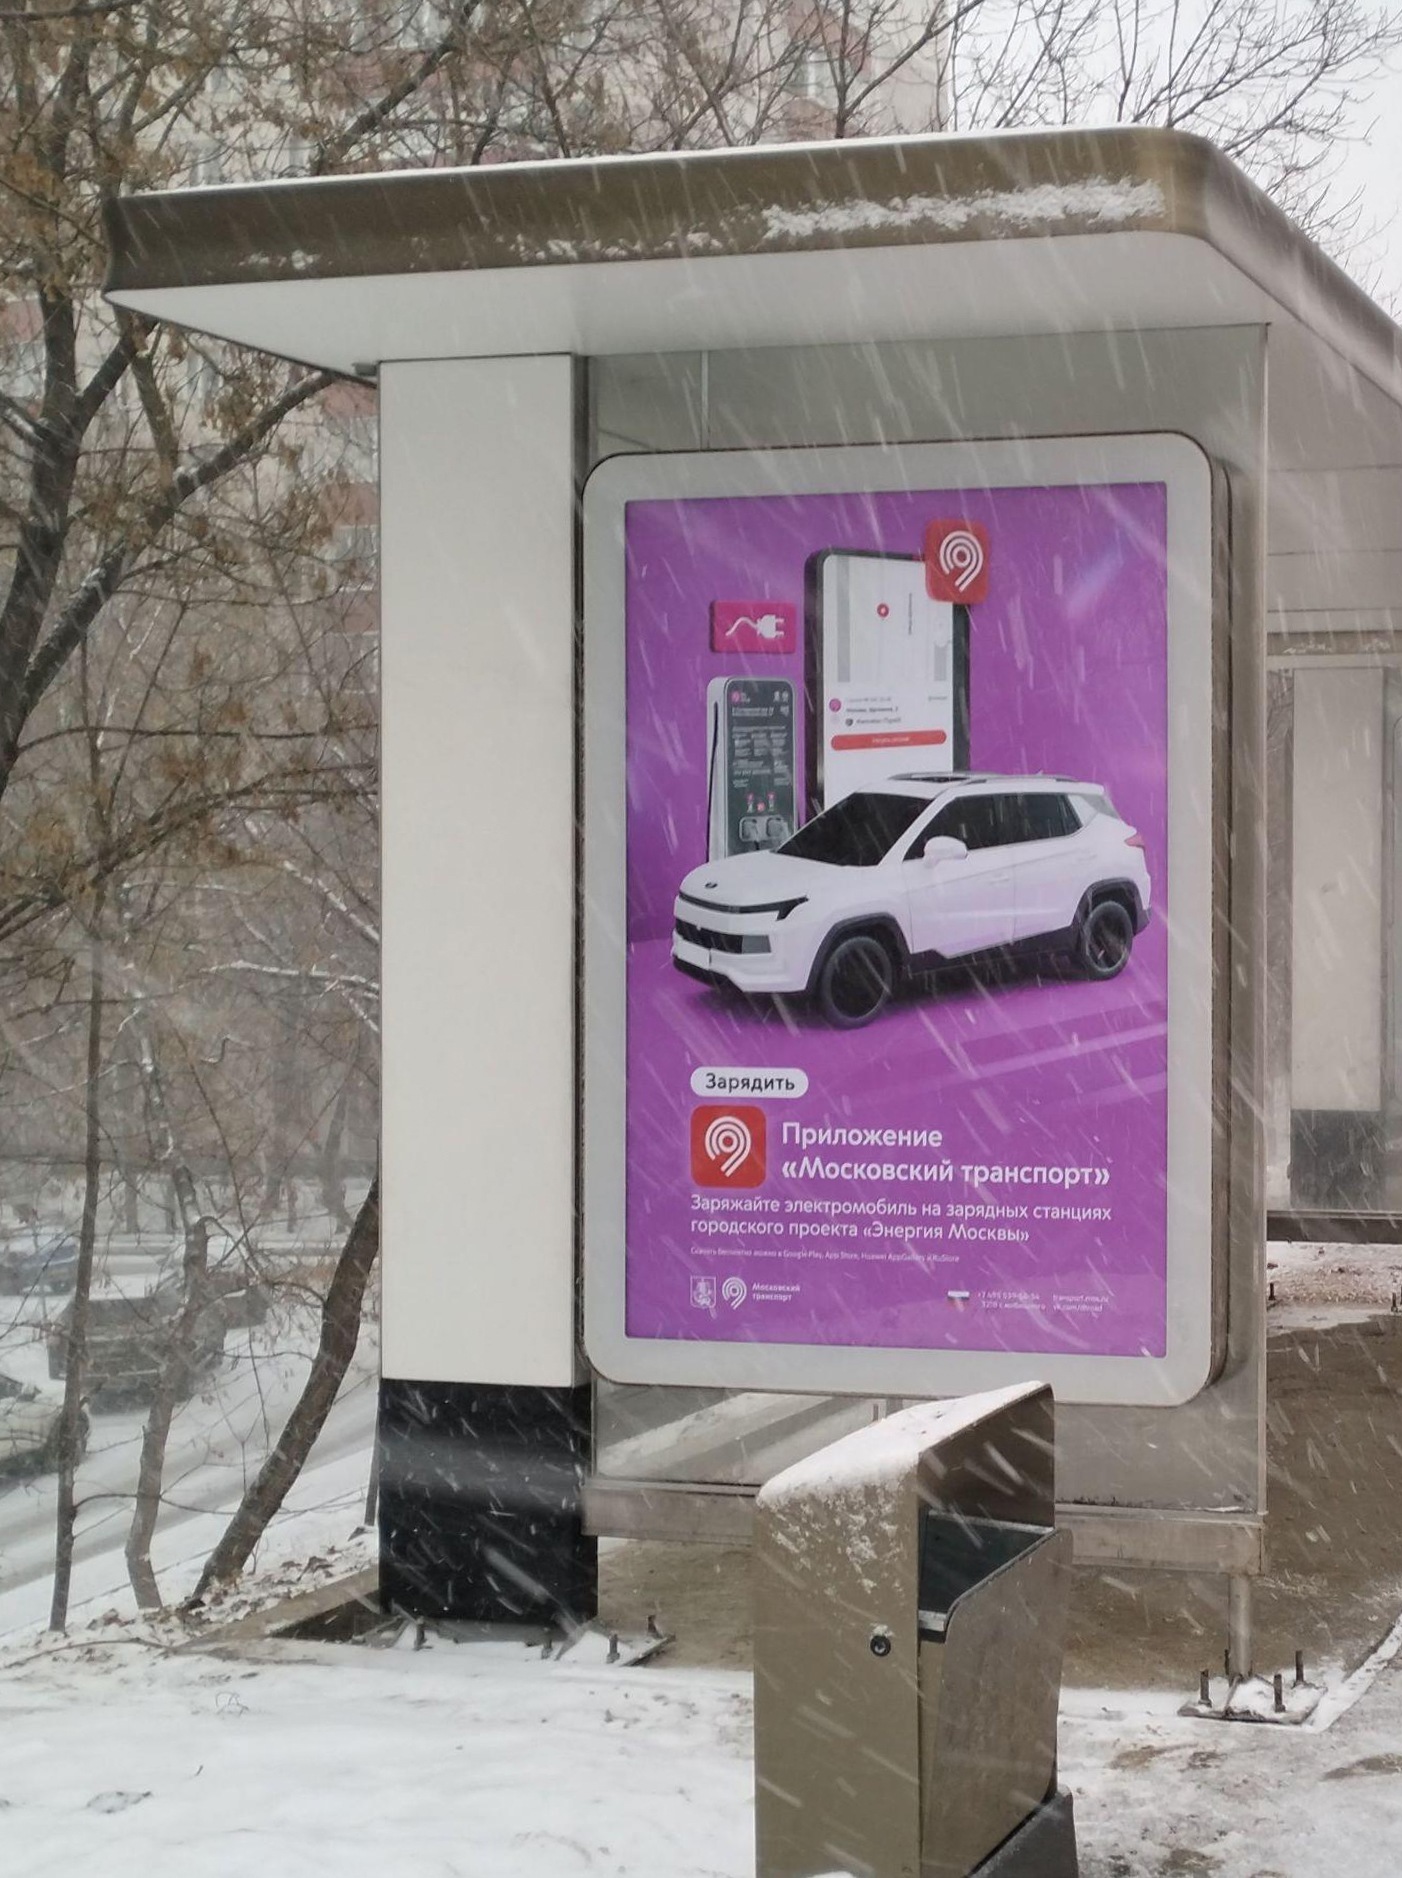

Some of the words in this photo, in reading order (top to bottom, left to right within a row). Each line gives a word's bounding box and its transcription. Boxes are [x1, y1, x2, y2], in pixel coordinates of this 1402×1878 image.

[705, 1073, 795, 1092] Зарядить
[782, 1122, 942, 1148] Приложение
[782, 1157, 953, 1182] «Московский
[961, 1162, 1110, 1188] транспорт»
[691, 1194, 780, 1214] Заряжайте
[784, 1198, 917, 1217] электромобиль
[922, 1204, 941, 1216] на
[946, 1204, 1028, 1222] зарядных
[1033, 1205, 1111, 1222] станциях
[691, 1220, 784, 1237] городского
[789, 1222, 858, 1240] проекта
[863, 1222, 942, 1242] «Энергия
[949, 1223, 1029, 1242] Москвы»
